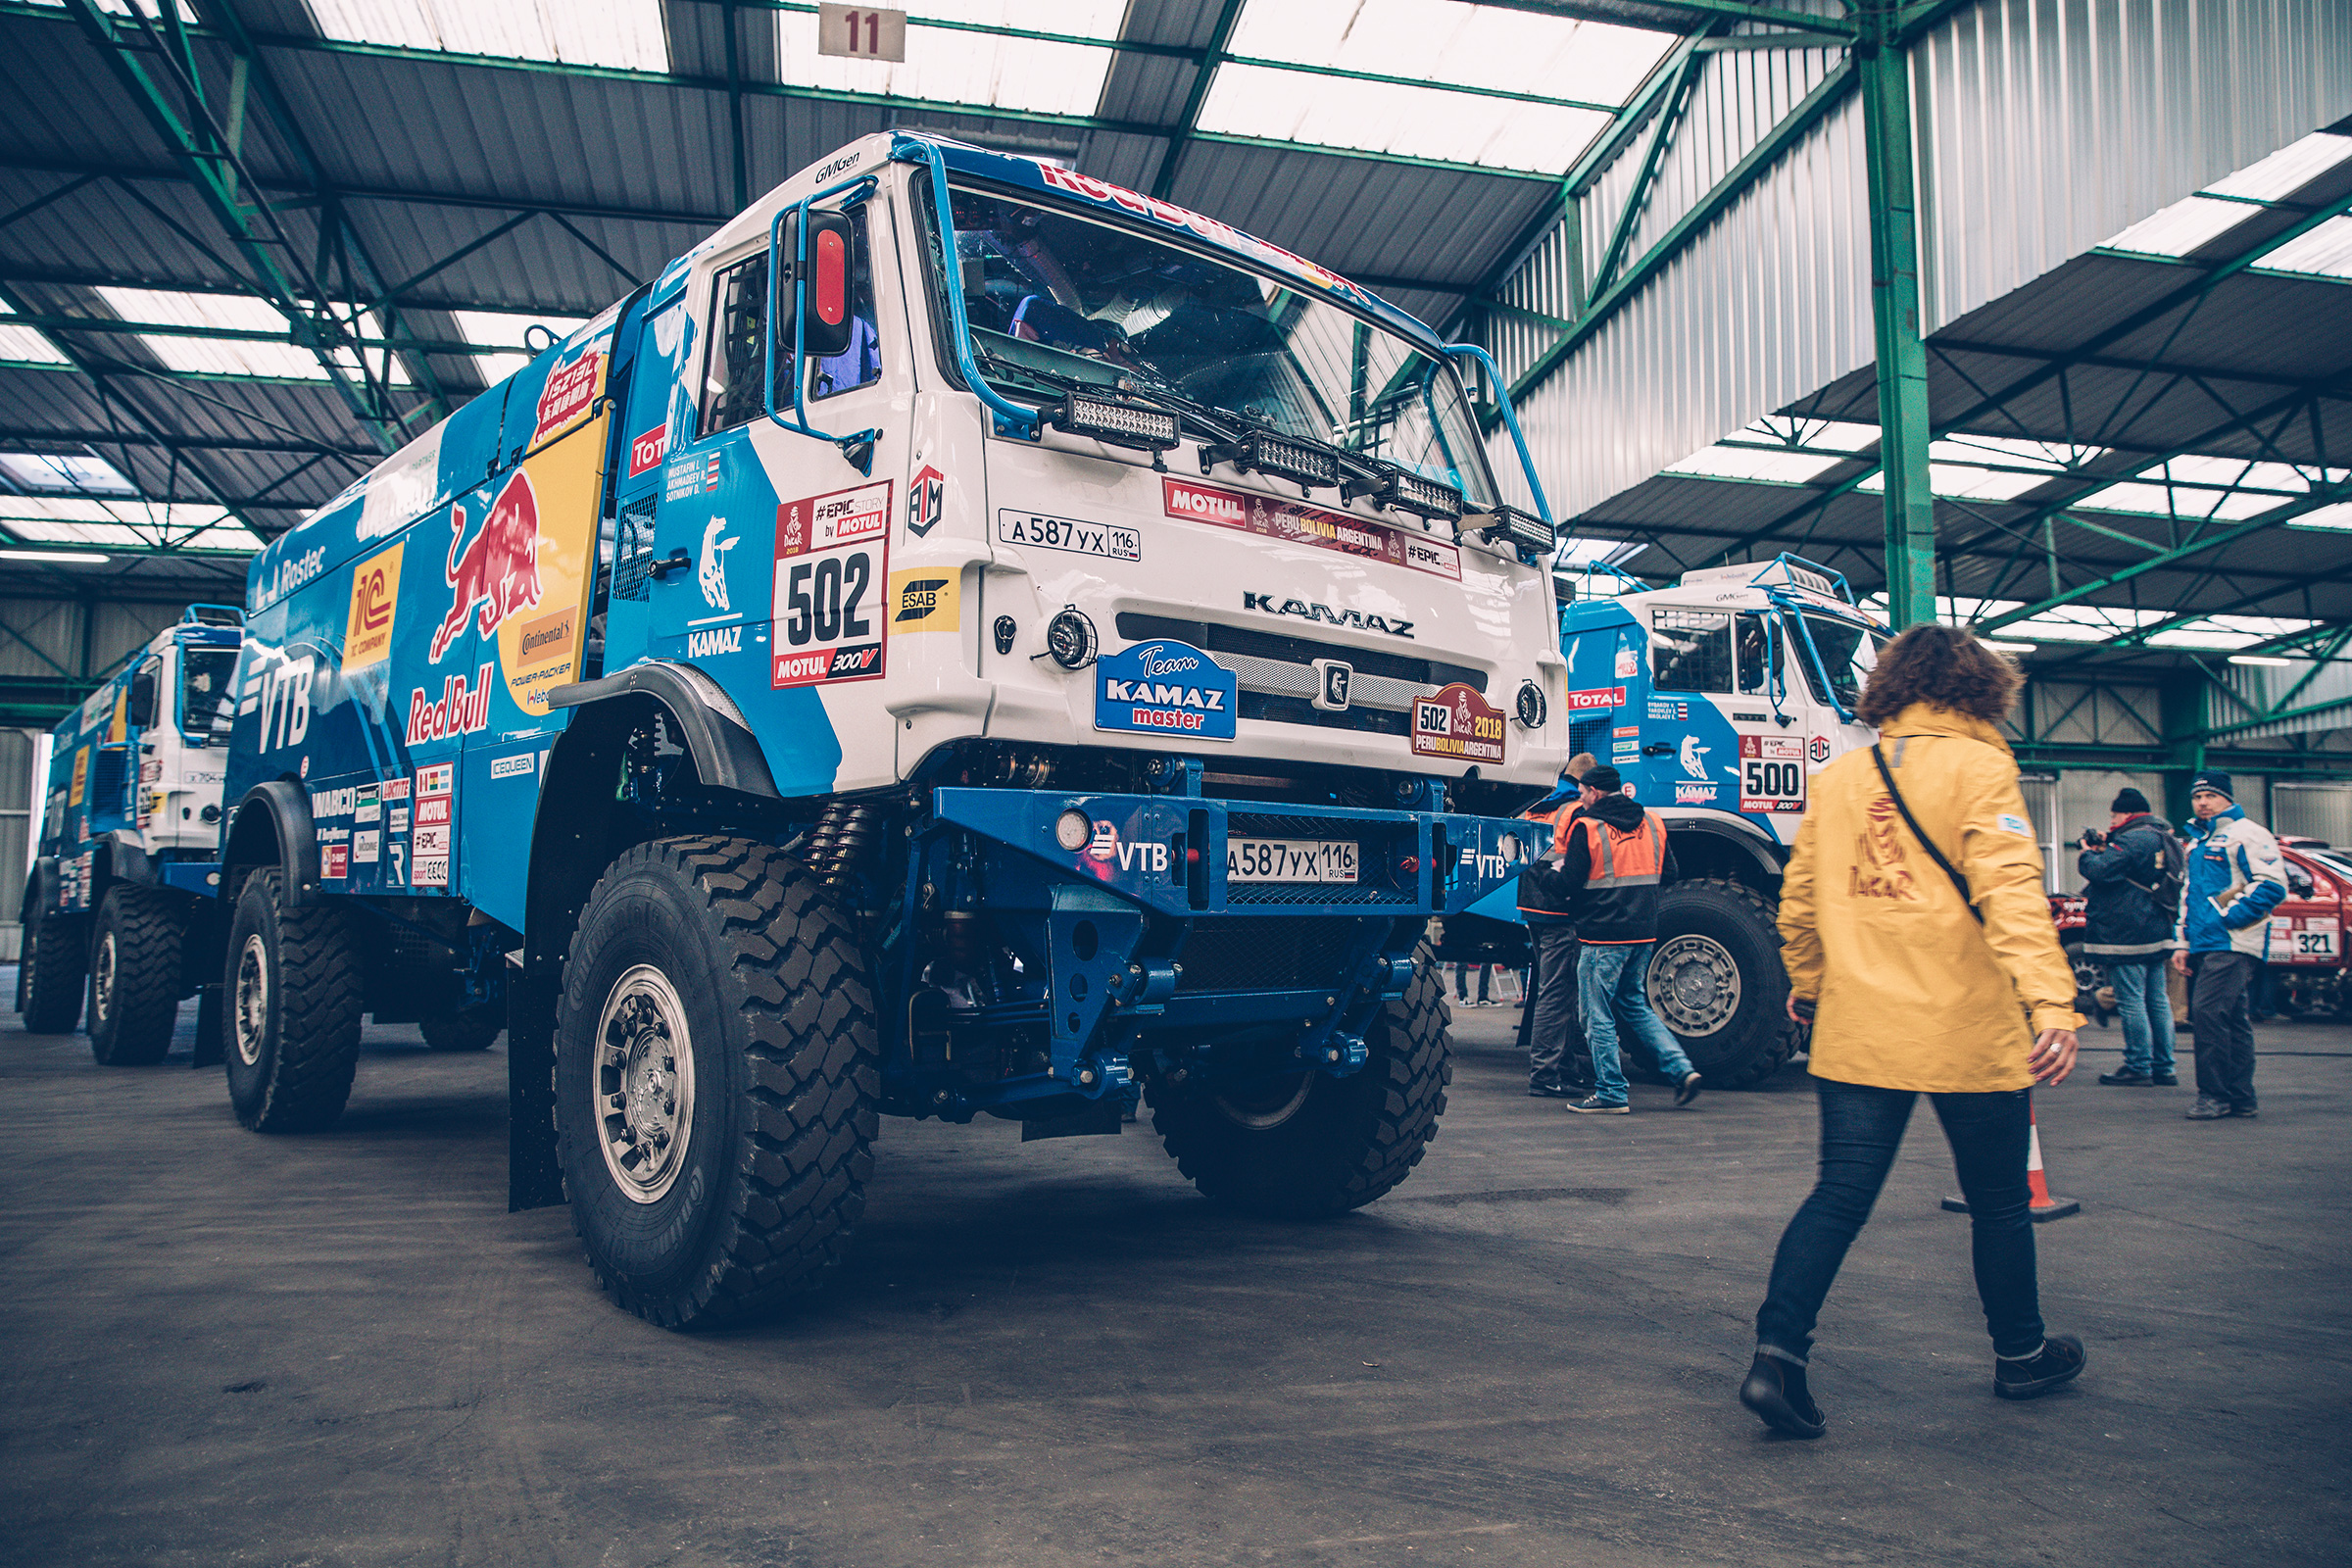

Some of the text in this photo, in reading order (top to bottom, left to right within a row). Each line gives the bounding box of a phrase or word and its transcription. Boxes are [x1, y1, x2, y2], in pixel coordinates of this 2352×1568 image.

[846, 10, 879, 54] 11
[815, 152, 860, 184] GMGen
[634, 436, 664, 467] TOT
[666, 471, 700, 491] AKHMADEEV
[667, 462, 696, 479] MUSTAFIN
[665, 485, 694, 503] SOTNIKOV
[1171, 489, 1242, 520] MOTUL
[825, 513, 881, 537] by MOTUL
[1274, 512, 1384, 551] PERU BOLIVIA ARGENTINA
[1112, 531, 1134, 549] 116
[1112, 547, 1129, 558] RUS
[281, 546, 325, 595] Rostec
[787, 552, 871, 647] 502
[901, 592, 937, 609] ESAB
[1243, 591, 1416, 639] KAMAZ
[521, 621, 564, 656] Continental
[688, 626, 742, 659] KAMAZ
[777, 648, 879, 679] MOTUL 300V
[1139, 645, 1199, 677] Team
[510, 662, 571, 688] POWER-PACKER
[259, 654, 316, 755] VTB
[405, 662, 494, 747] Red Bull
[1105, 677, 1225, 711] KAMAZ
[1570, 693, 1623, 707] TOTAL
[1133, 708, 1204, 730] master
[1420, 705, 1447, 732] 502
[1474, 715, 1502, 740] 2018
[493, 758, 532, 774] ICEQUEEN
[1746, 761, 1799, 797] 500
[312, 787, 357, 819] WABCO
[1675, 787, 1718, 800] KAMAZ
[1742, 800, 1802, 810] MOTUL 300V
[418, 800, 448, 821] MOTUL
[1115, 842, 1168, 872] VTB
[1321, 844, 1353, 869] 116
[1475, 854, 1505, 879] VTB
[1328, 869, 1346, 878] RUS
[2298, 933, 2333, 954] 321
